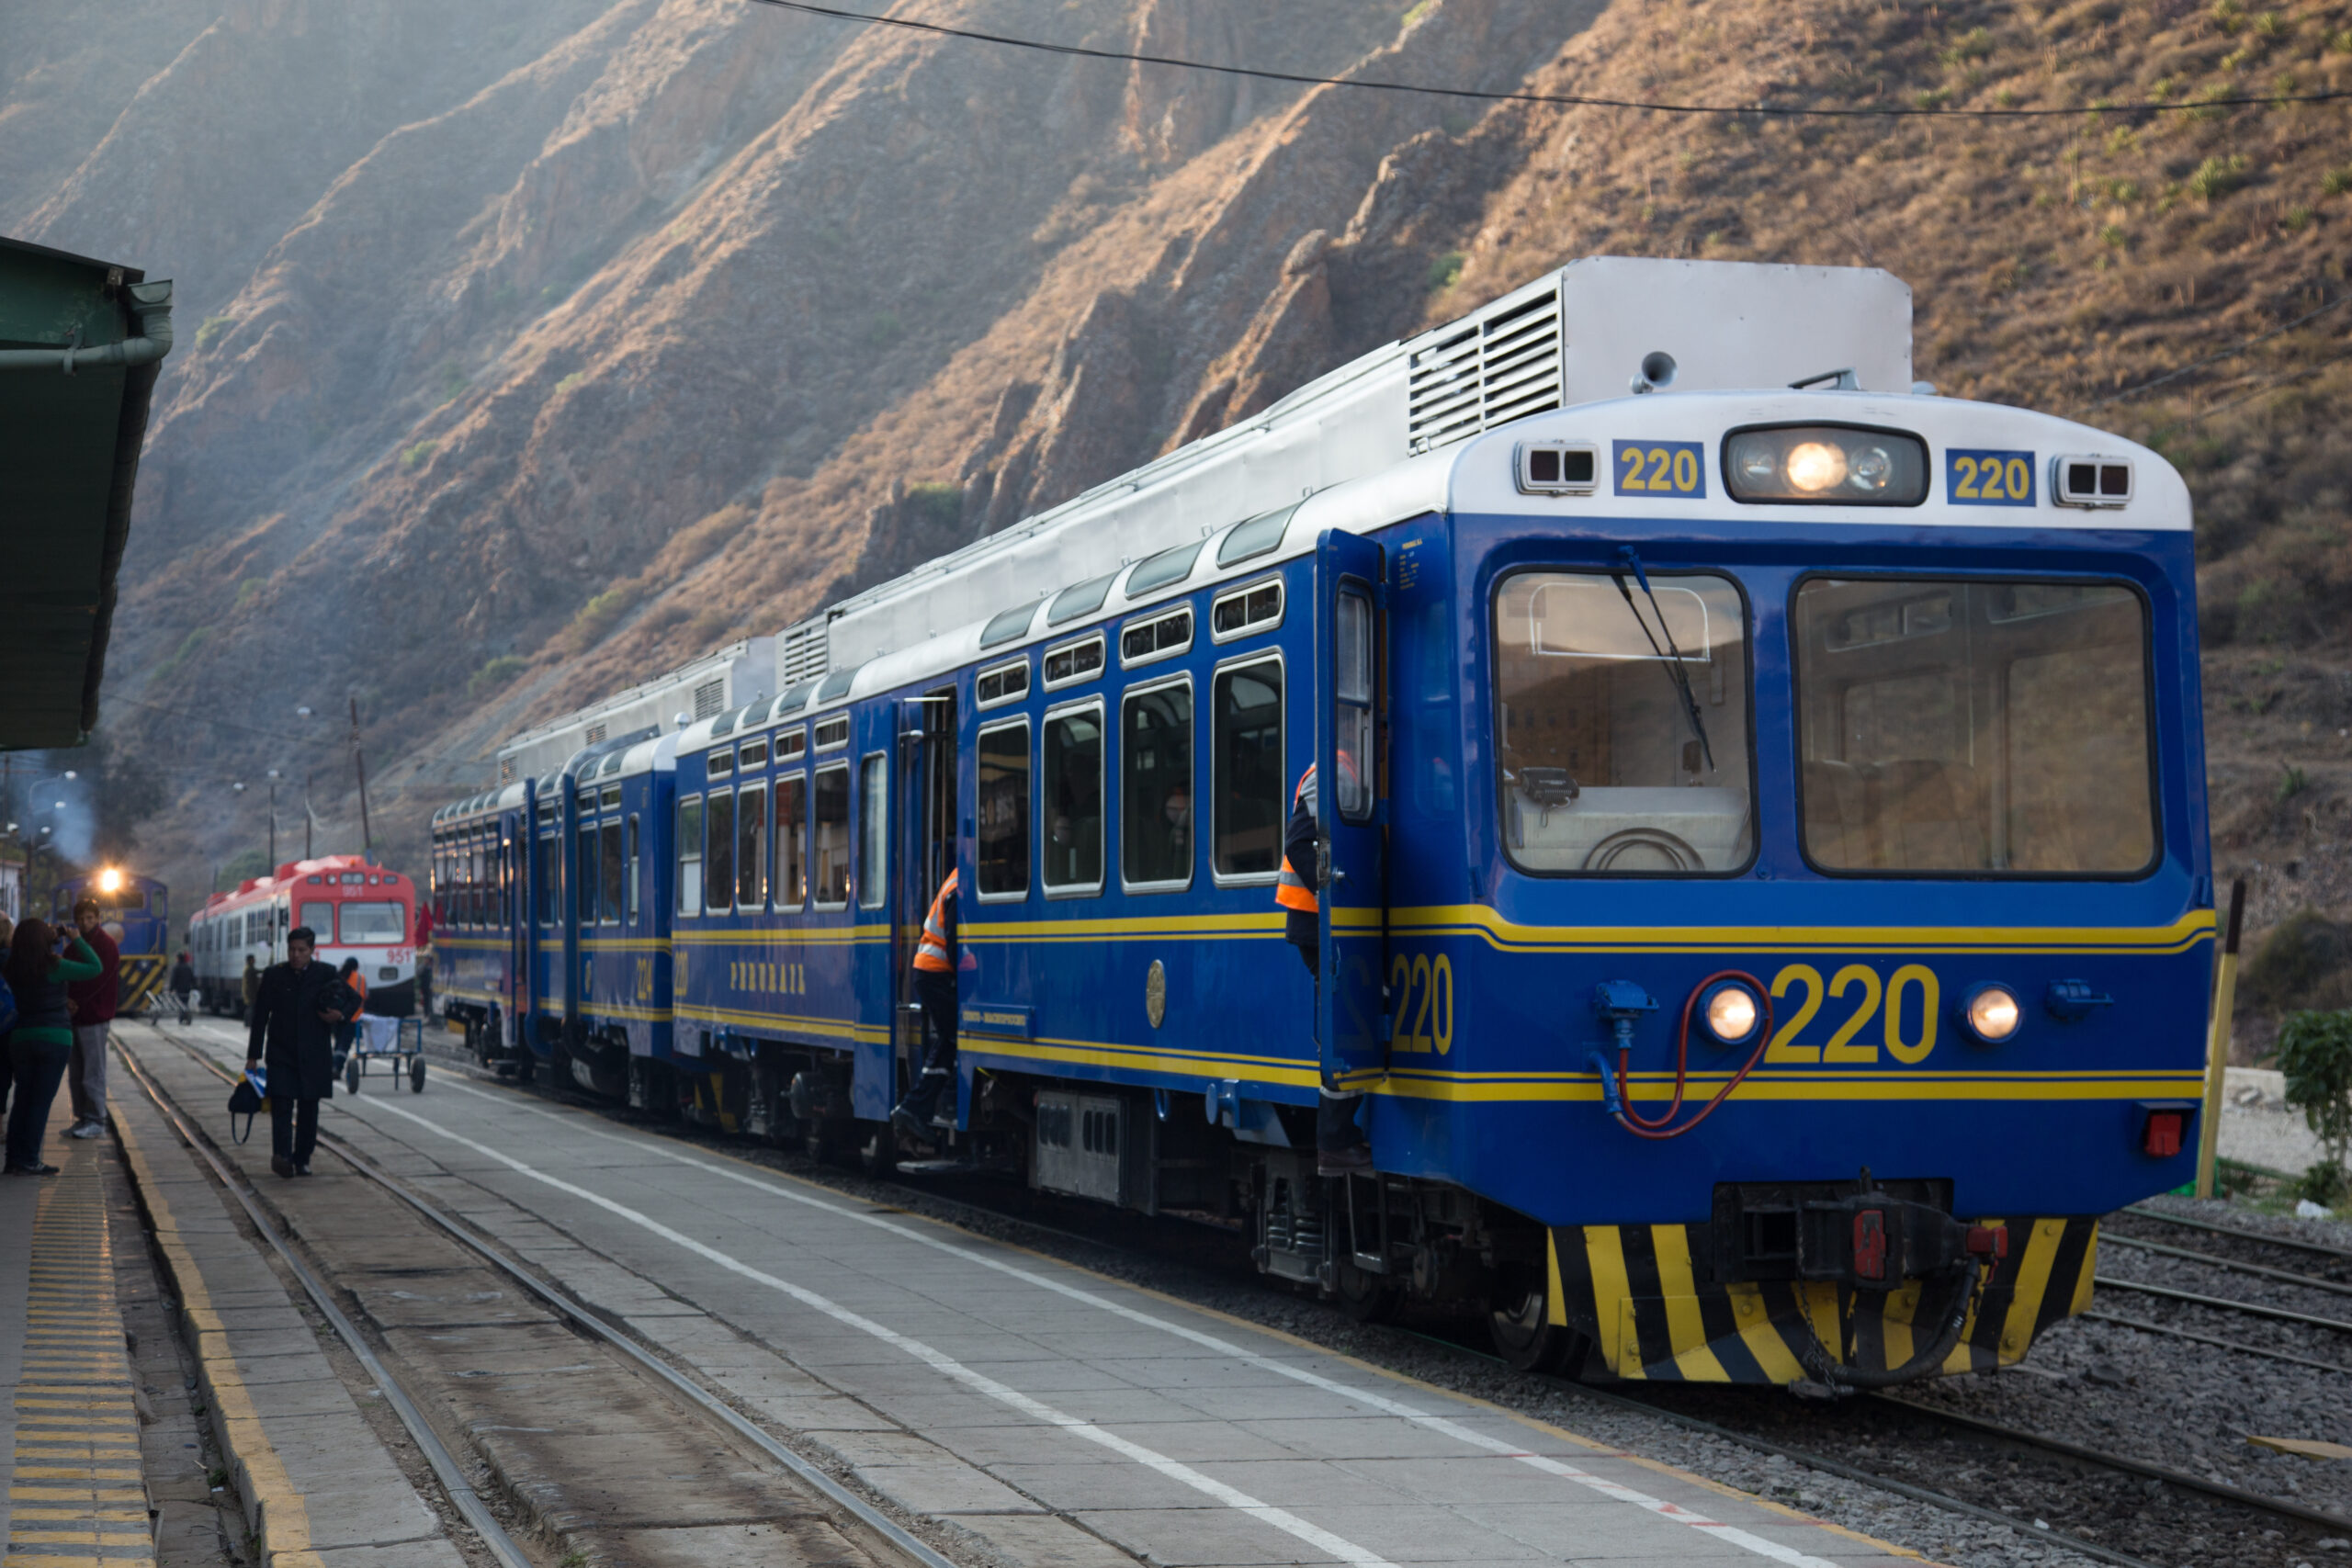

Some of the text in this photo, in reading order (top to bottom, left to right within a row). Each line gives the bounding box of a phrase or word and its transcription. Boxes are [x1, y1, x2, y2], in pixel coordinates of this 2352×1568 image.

[1621, 447, 1698, 491] 220
[1954, 457, 2030, 500] 220
[387, 950, 412, 964] 951
[1391, 953, 1453, 1055] 220
[1763, 964, 1940, 1065] 220
